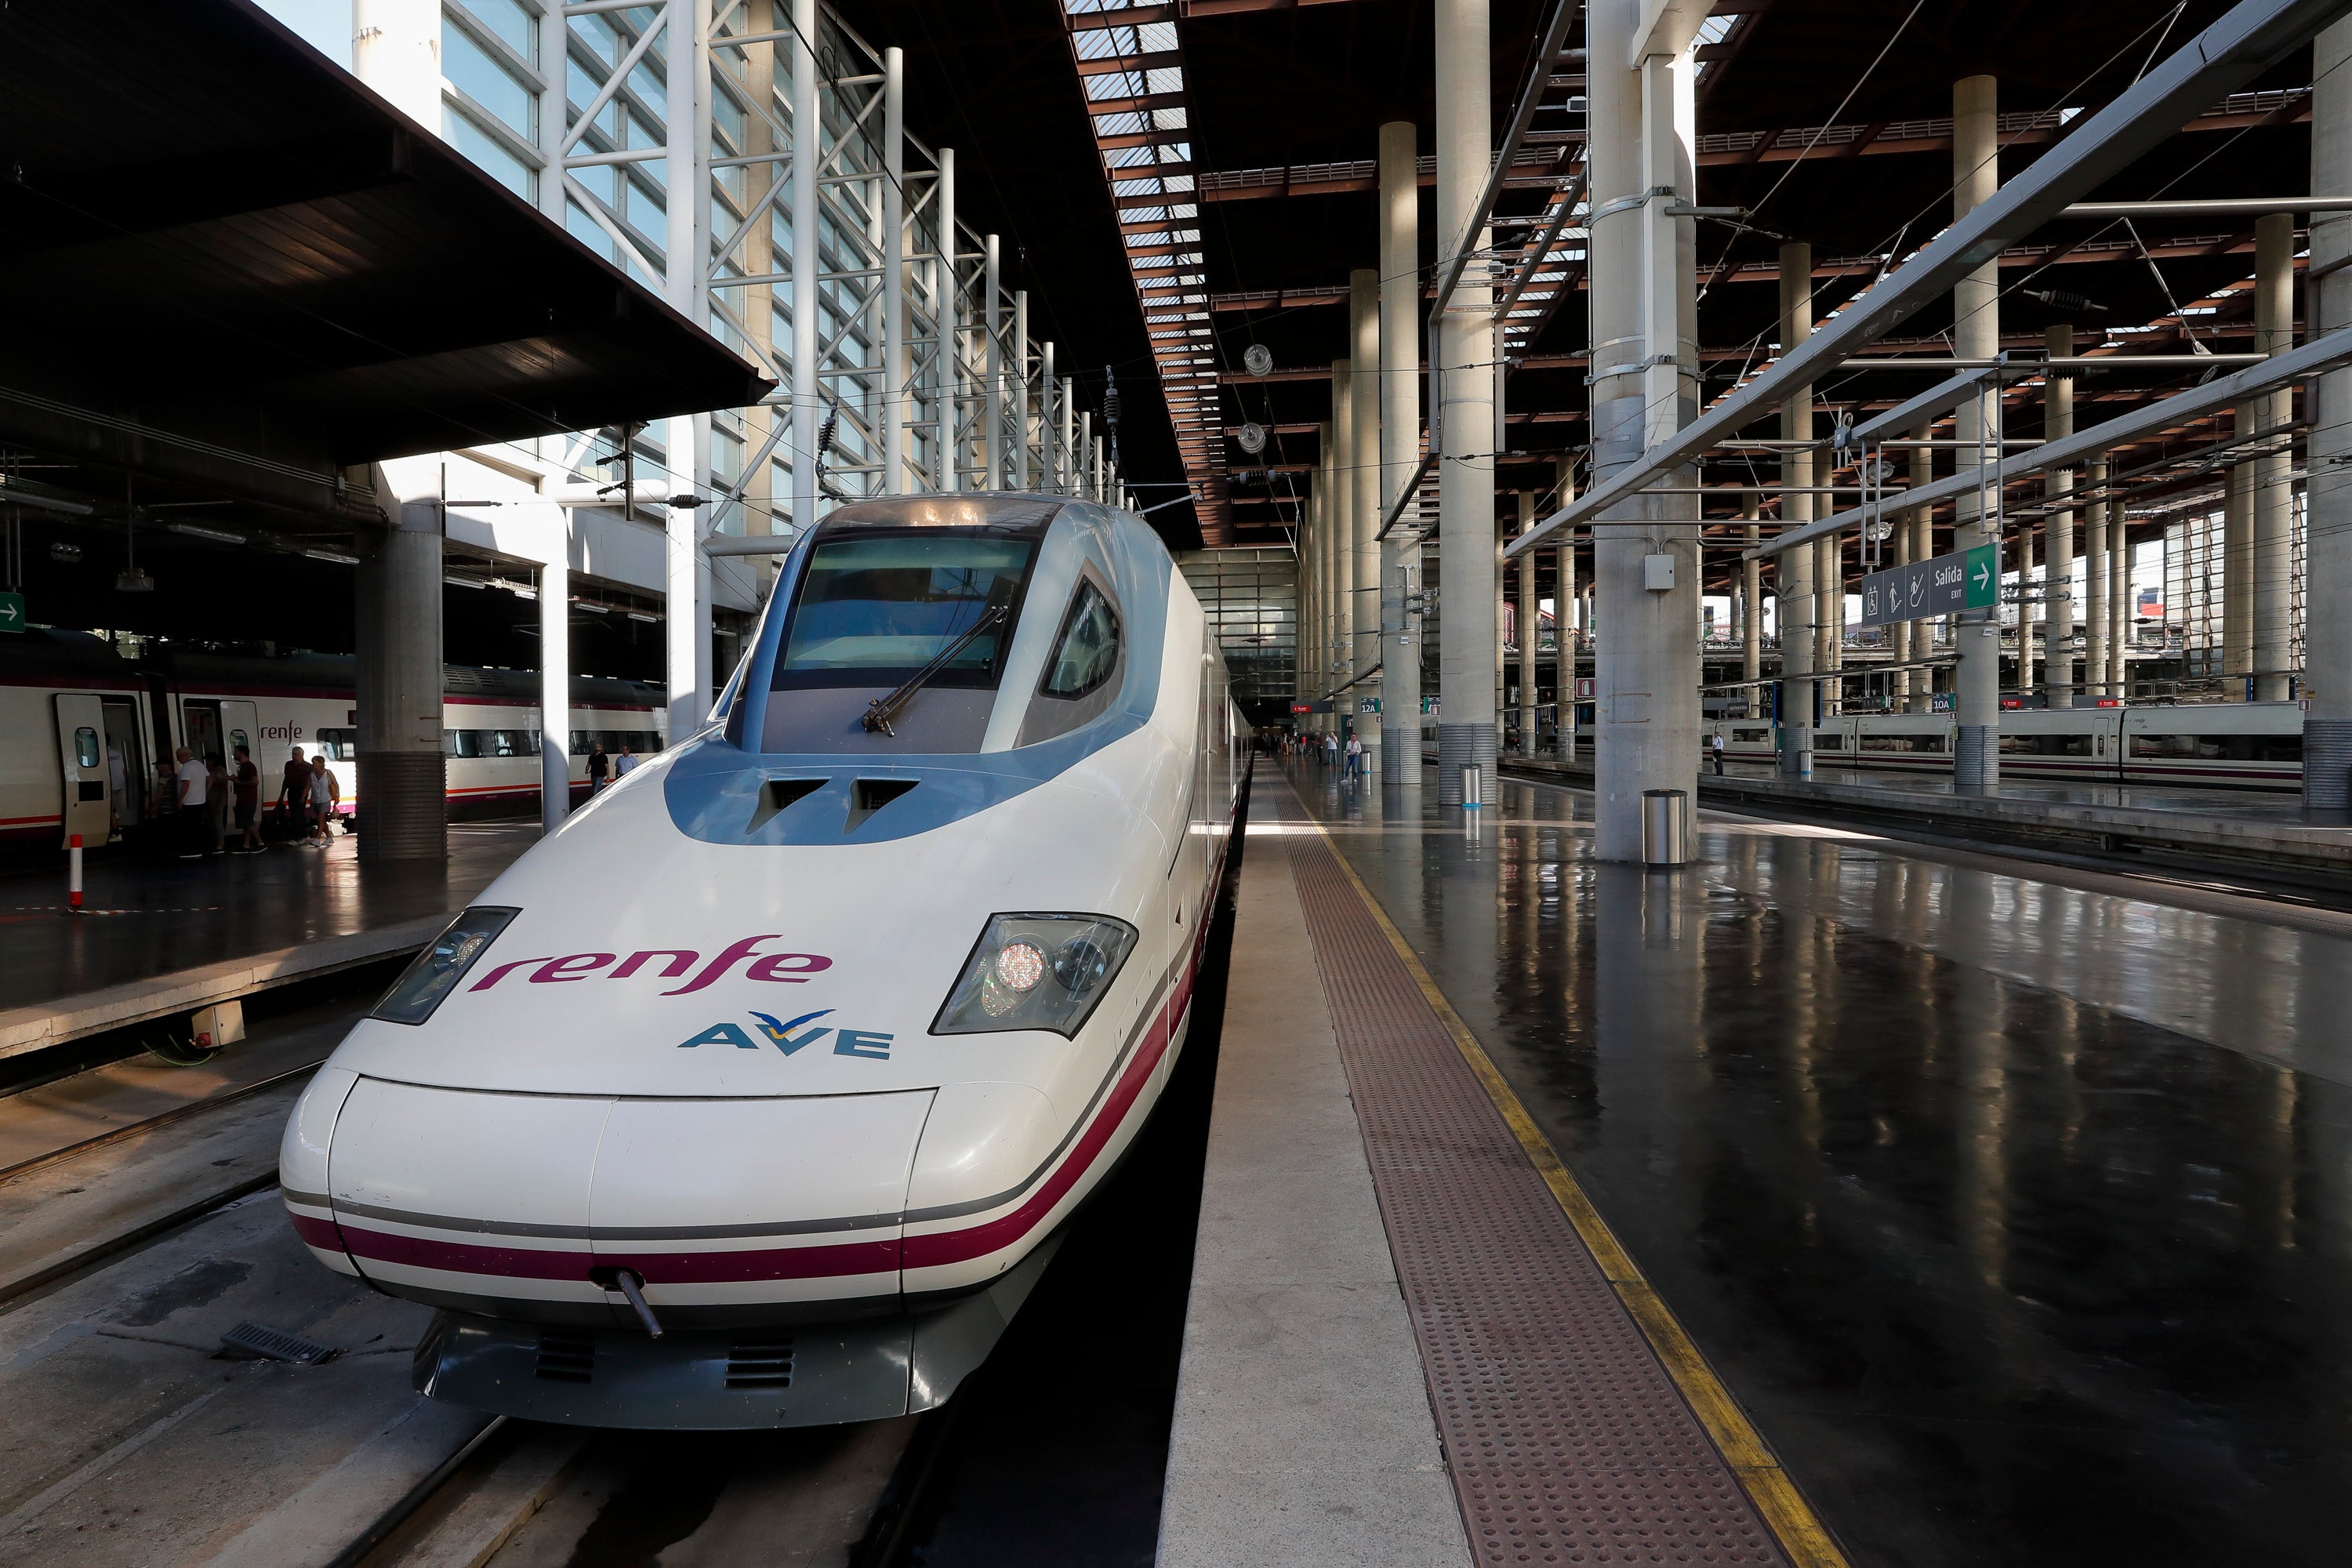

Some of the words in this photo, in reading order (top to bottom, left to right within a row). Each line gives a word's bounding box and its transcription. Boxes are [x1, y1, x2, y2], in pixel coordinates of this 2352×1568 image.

[1935, 565, 1962, 586] Salida
[1951, 589, 1962, 600] EXIT
[1361, 704, 1376, 713] 12A
[1933, 700, 1950, 710] 10A
[260, 719, 303, 746] renfe
[467, 934, 833, 996] renfe
[677, 1010, 895, 1060] AVE
